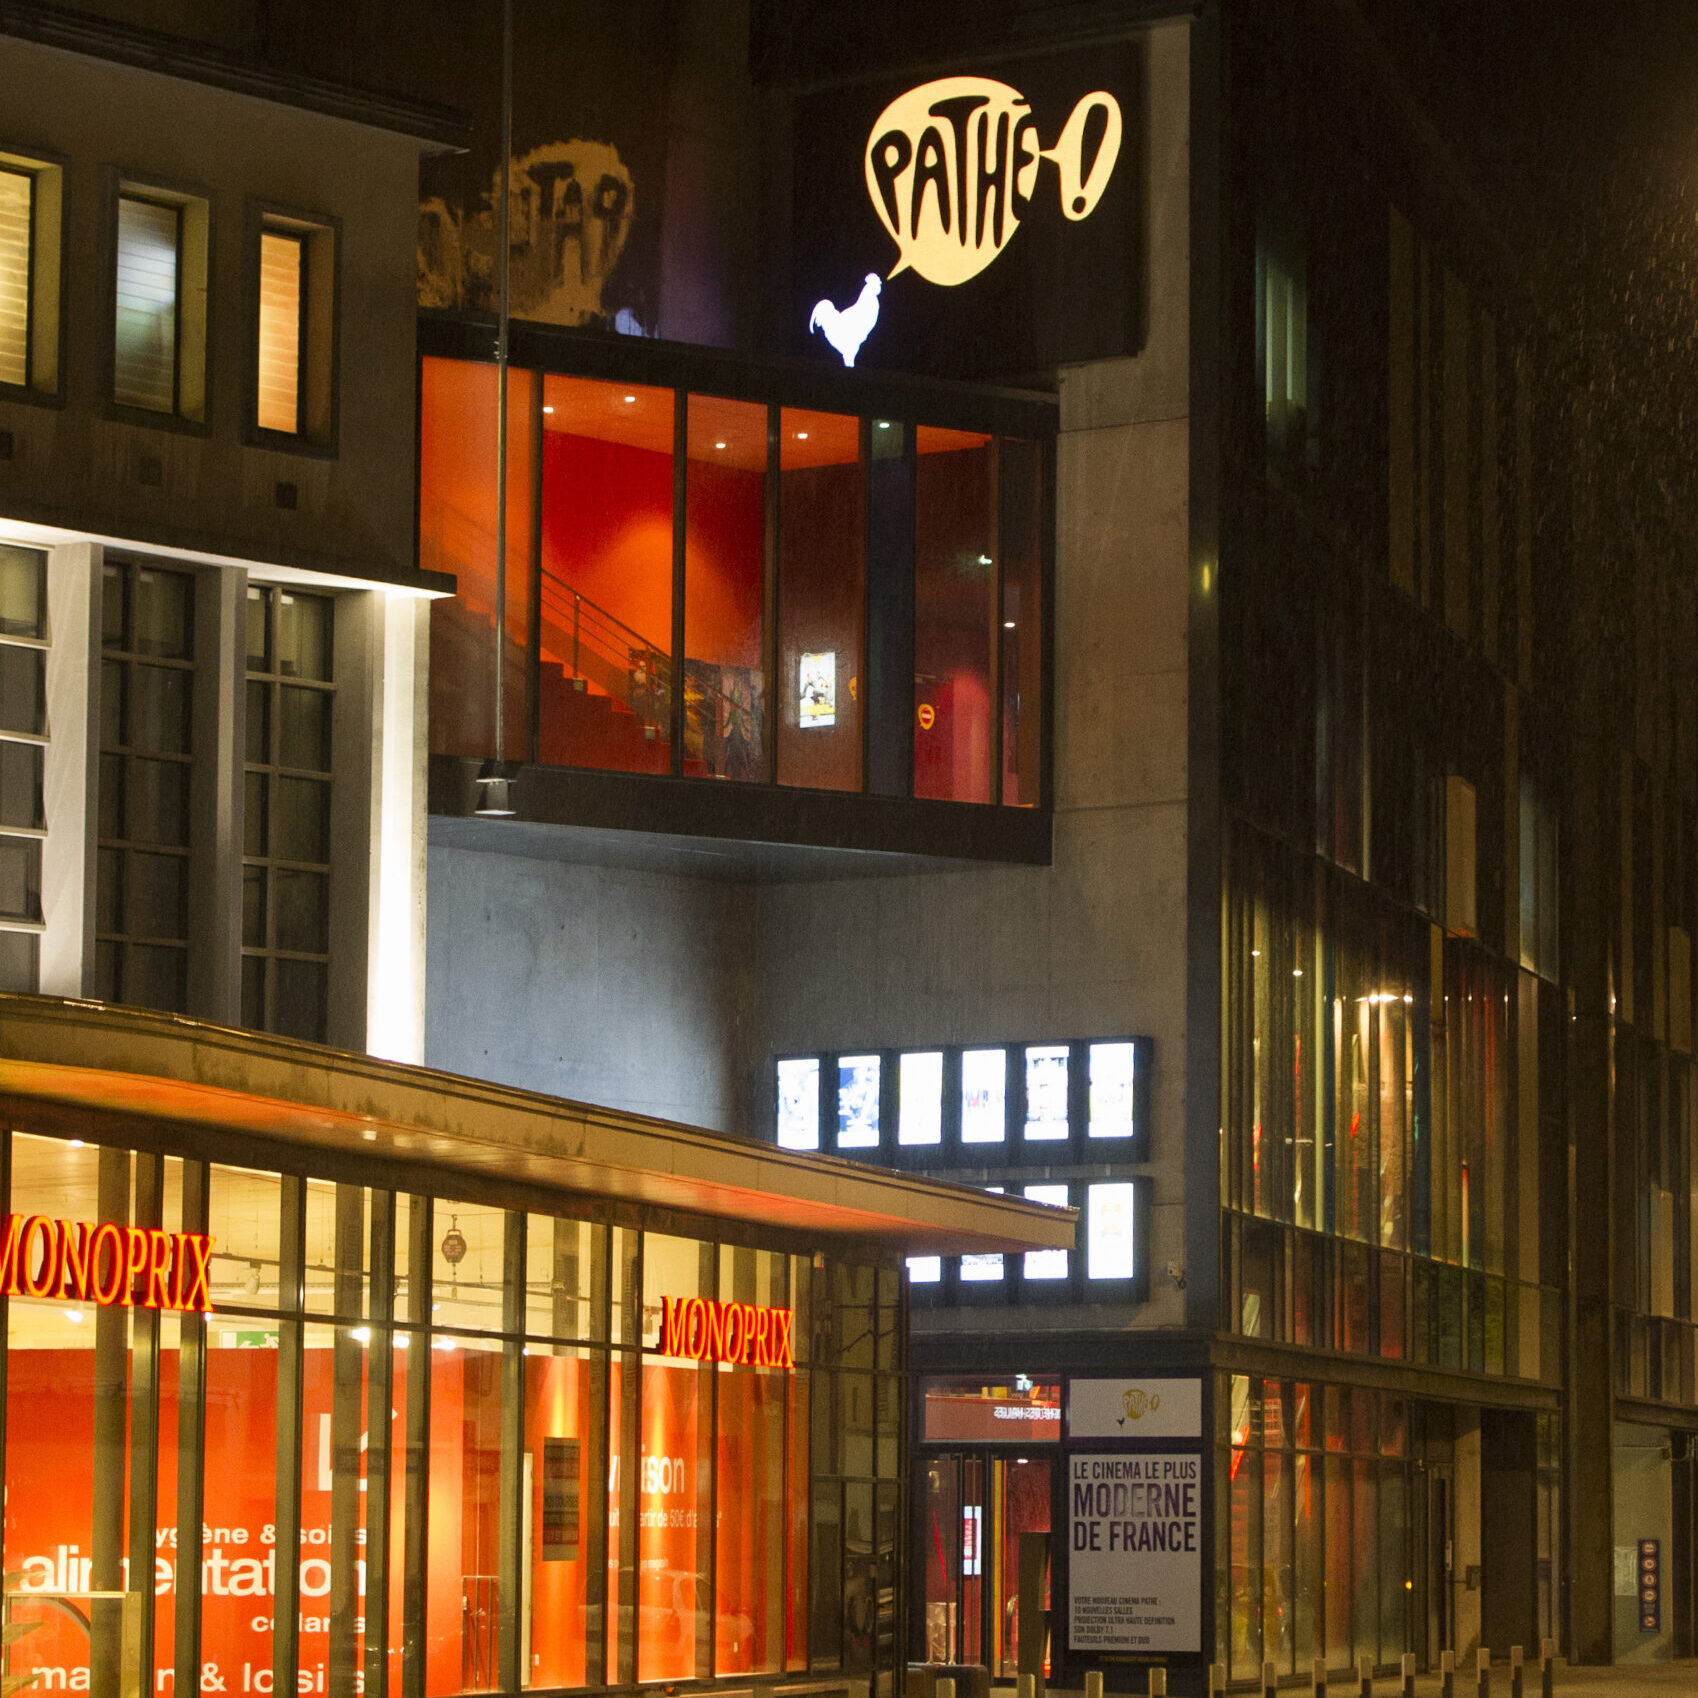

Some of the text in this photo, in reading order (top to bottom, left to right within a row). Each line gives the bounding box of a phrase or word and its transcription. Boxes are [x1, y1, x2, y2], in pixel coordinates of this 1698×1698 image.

[662, 1295, 793, 1369] MONOPRIX
[1074, 1461, 1197, 1480] LE CINEMA LE PLUS
[1073, 1482, 1197, 1518] MODERNE
[1073, 1520, 1197, 1552] DE FRANCE
[1092, 1596, 1118, 1605] NOUVEAU
[1082, 1606, 1113, 1614] NOUVELLES
[1113, 1606, 1133, 1614] SALLES
[1074, 1615, 1107, 1624] PROJECTION
[1108, 1616, 1125, 1624] ULTRA
[1125, 1616, 1143, 1624] HAUTE
[1074, 1625, 1085, 1634] SON
[1086, 1625, 1103, 1634] DOLBY
[1074, 1635, 1102, 1644] FAUTEUILS
